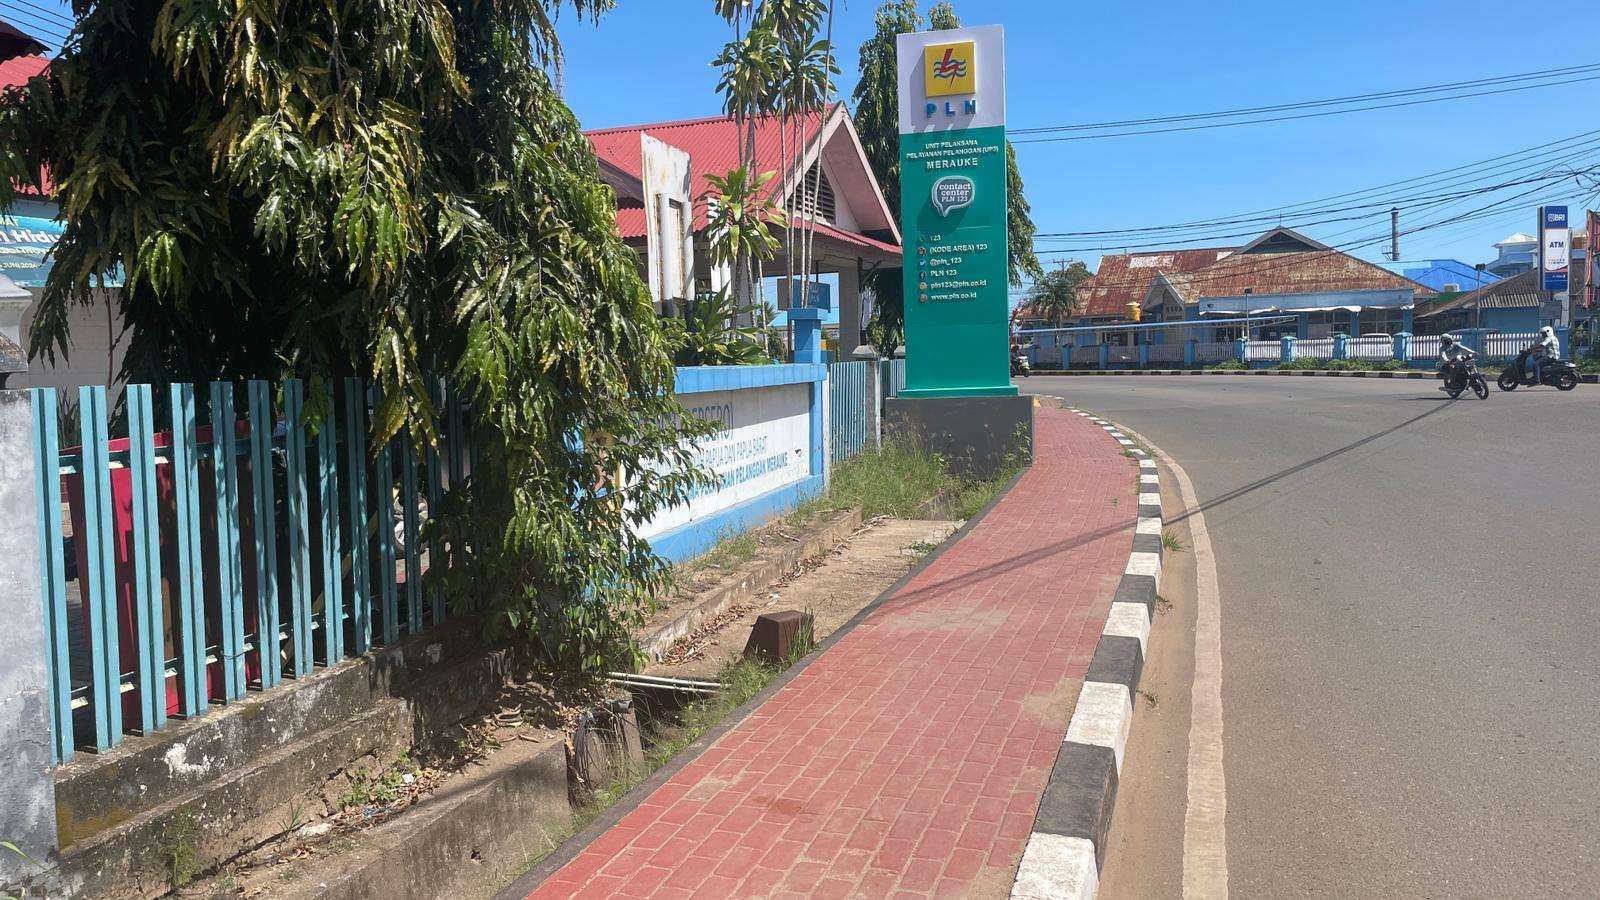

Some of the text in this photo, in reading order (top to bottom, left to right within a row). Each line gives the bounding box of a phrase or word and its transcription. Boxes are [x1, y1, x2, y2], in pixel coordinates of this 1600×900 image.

[926, 100, 976, 118] PLN
[925, 139, 978, 150] UNIT PELAKSANA
[906, 150, 942, 159] PELAYANAN
[926, 158, 979, 169] MERAUKE
[929, 247, 952, 255] (KODE
[952, 245, 975, 253] AREA)
[1549, 241, 1564, 249] ATM
[930, 257, 962, 266] @pln_123
[930, 280, 987, 290] pln123@pln.co.id
[736, 459, 766, 484] PELANGGAN
